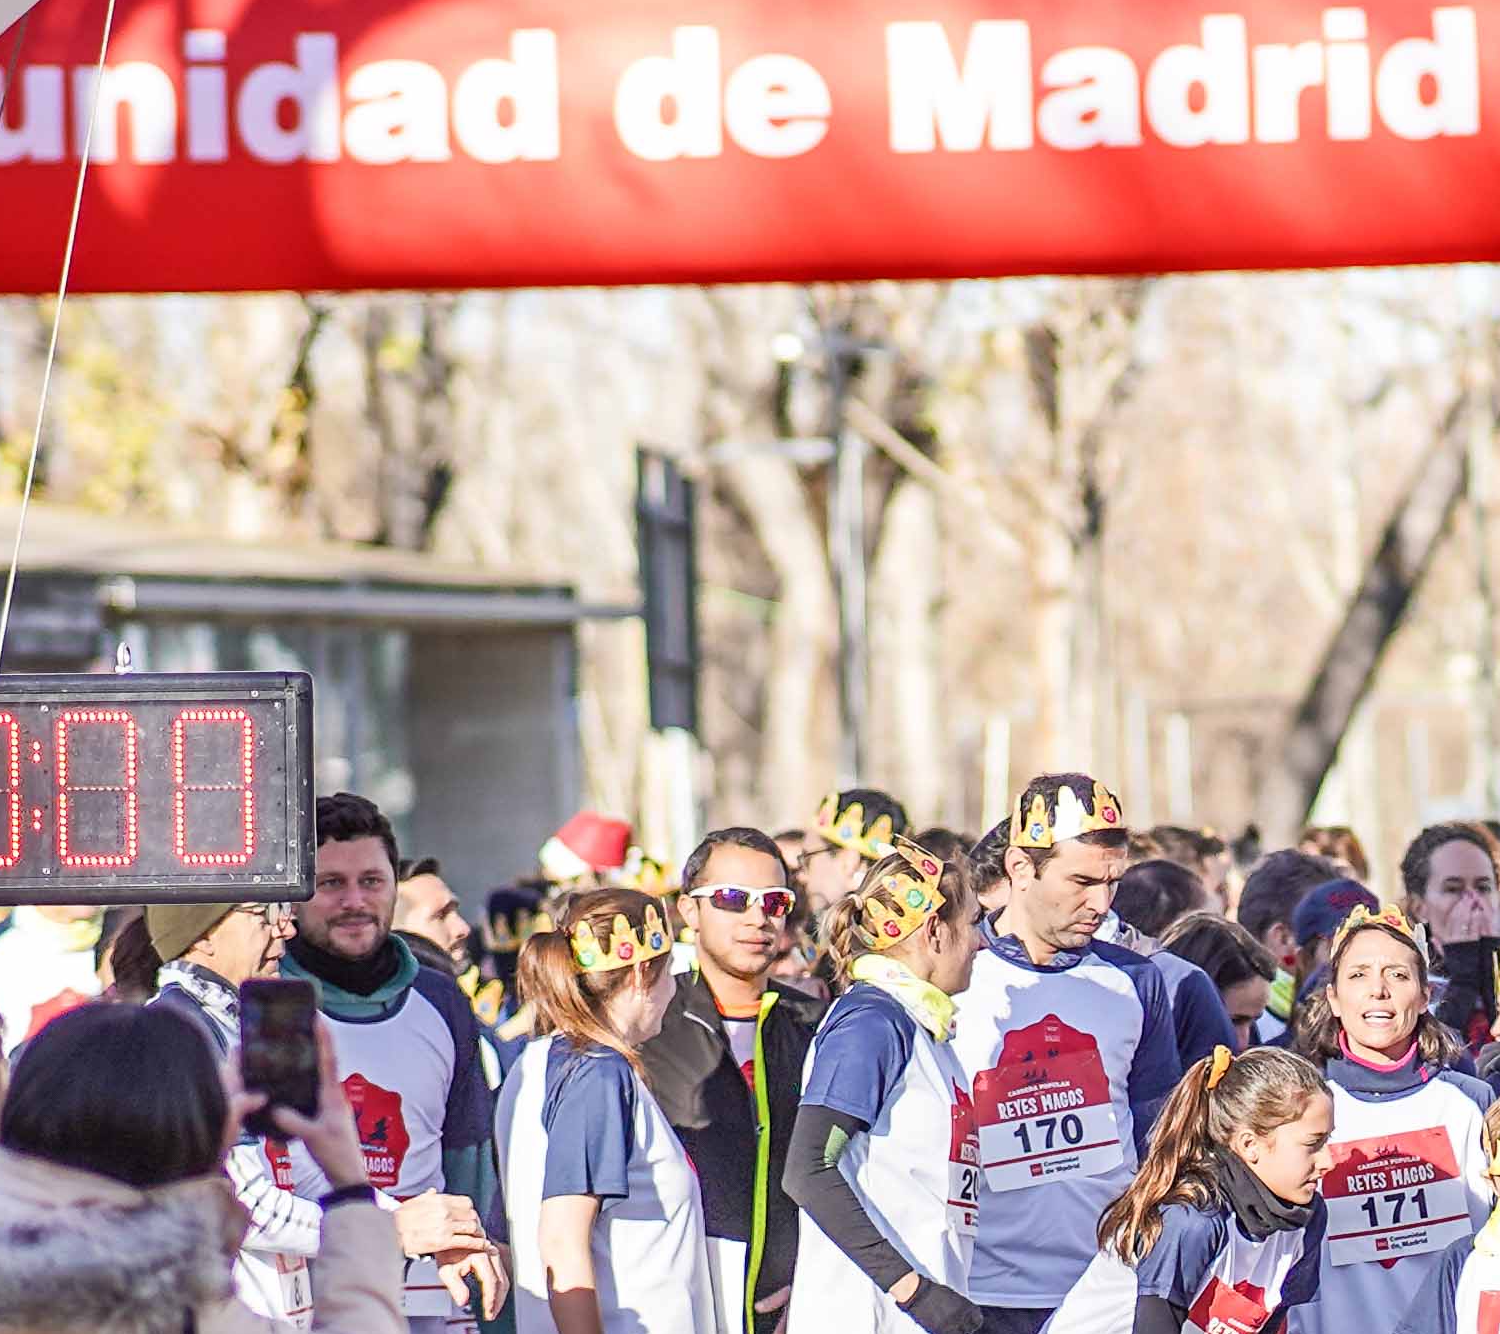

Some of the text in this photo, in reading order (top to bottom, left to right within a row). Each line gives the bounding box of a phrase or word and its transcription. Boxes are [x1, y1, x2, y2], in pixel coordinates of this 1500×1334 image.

[613, 24, 831, 160] de
[887, 7, 1481, 155] Madrid
[997, 1088, 1085, 1120] REYES MAGOS
[1014, 1114, 1084, 1154] 170
[1347, 1163, 1435, 1192] REYES MAGOS
[1361, 1188, 1429, 1227] 171
